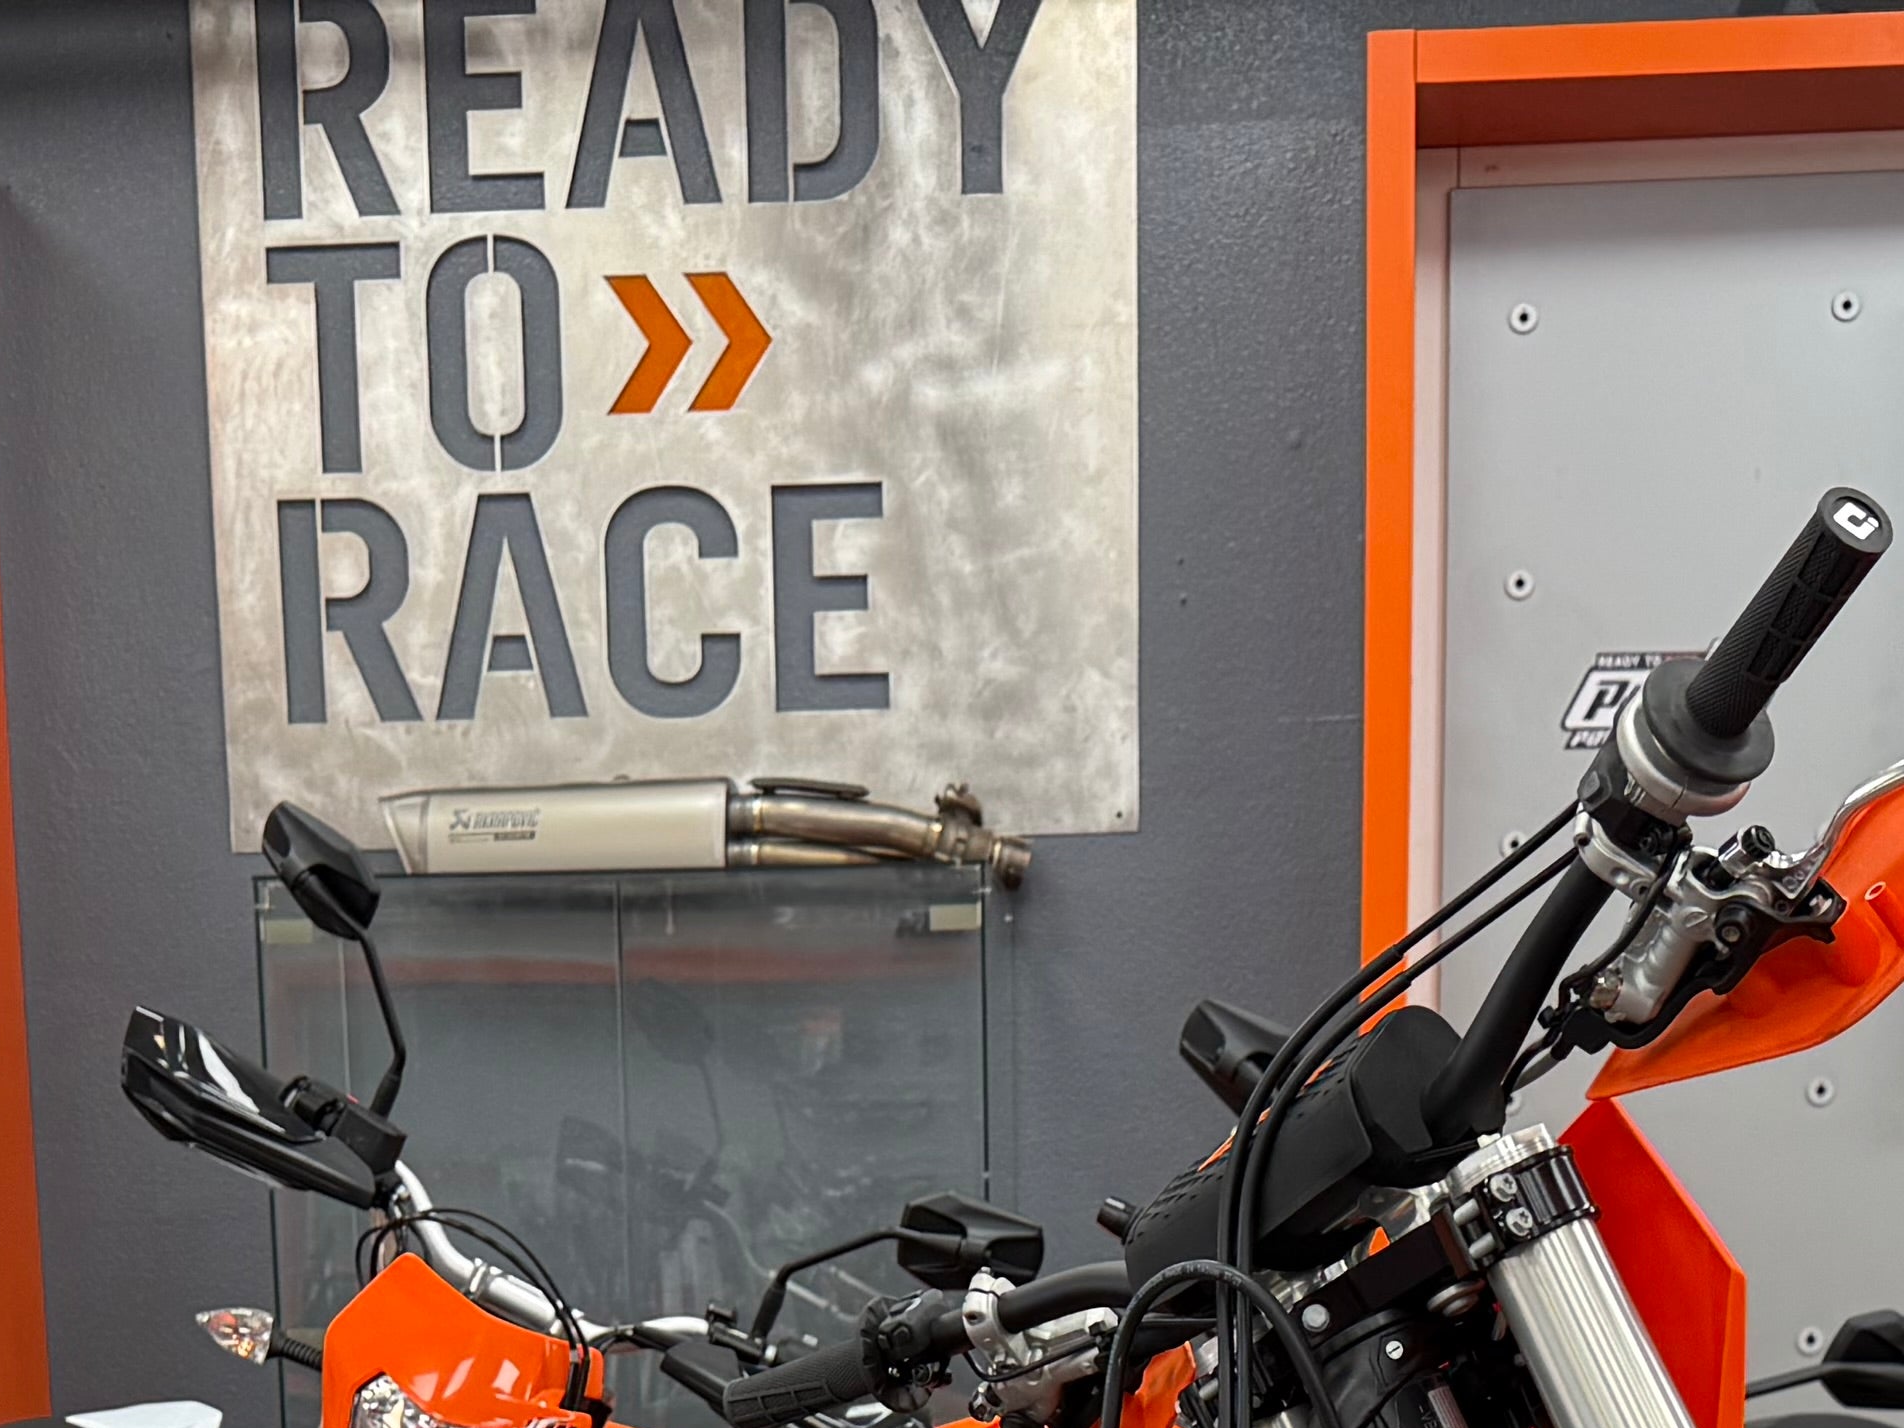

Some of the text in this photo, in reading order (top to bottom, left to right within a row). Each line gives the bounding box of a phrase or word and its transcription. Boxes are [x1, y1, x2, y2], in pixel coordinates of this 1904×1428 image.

[258, 0, 1040, 220] READY
[264, 234, 564, 473] TO
[277, 481, 891, 724] RACE
